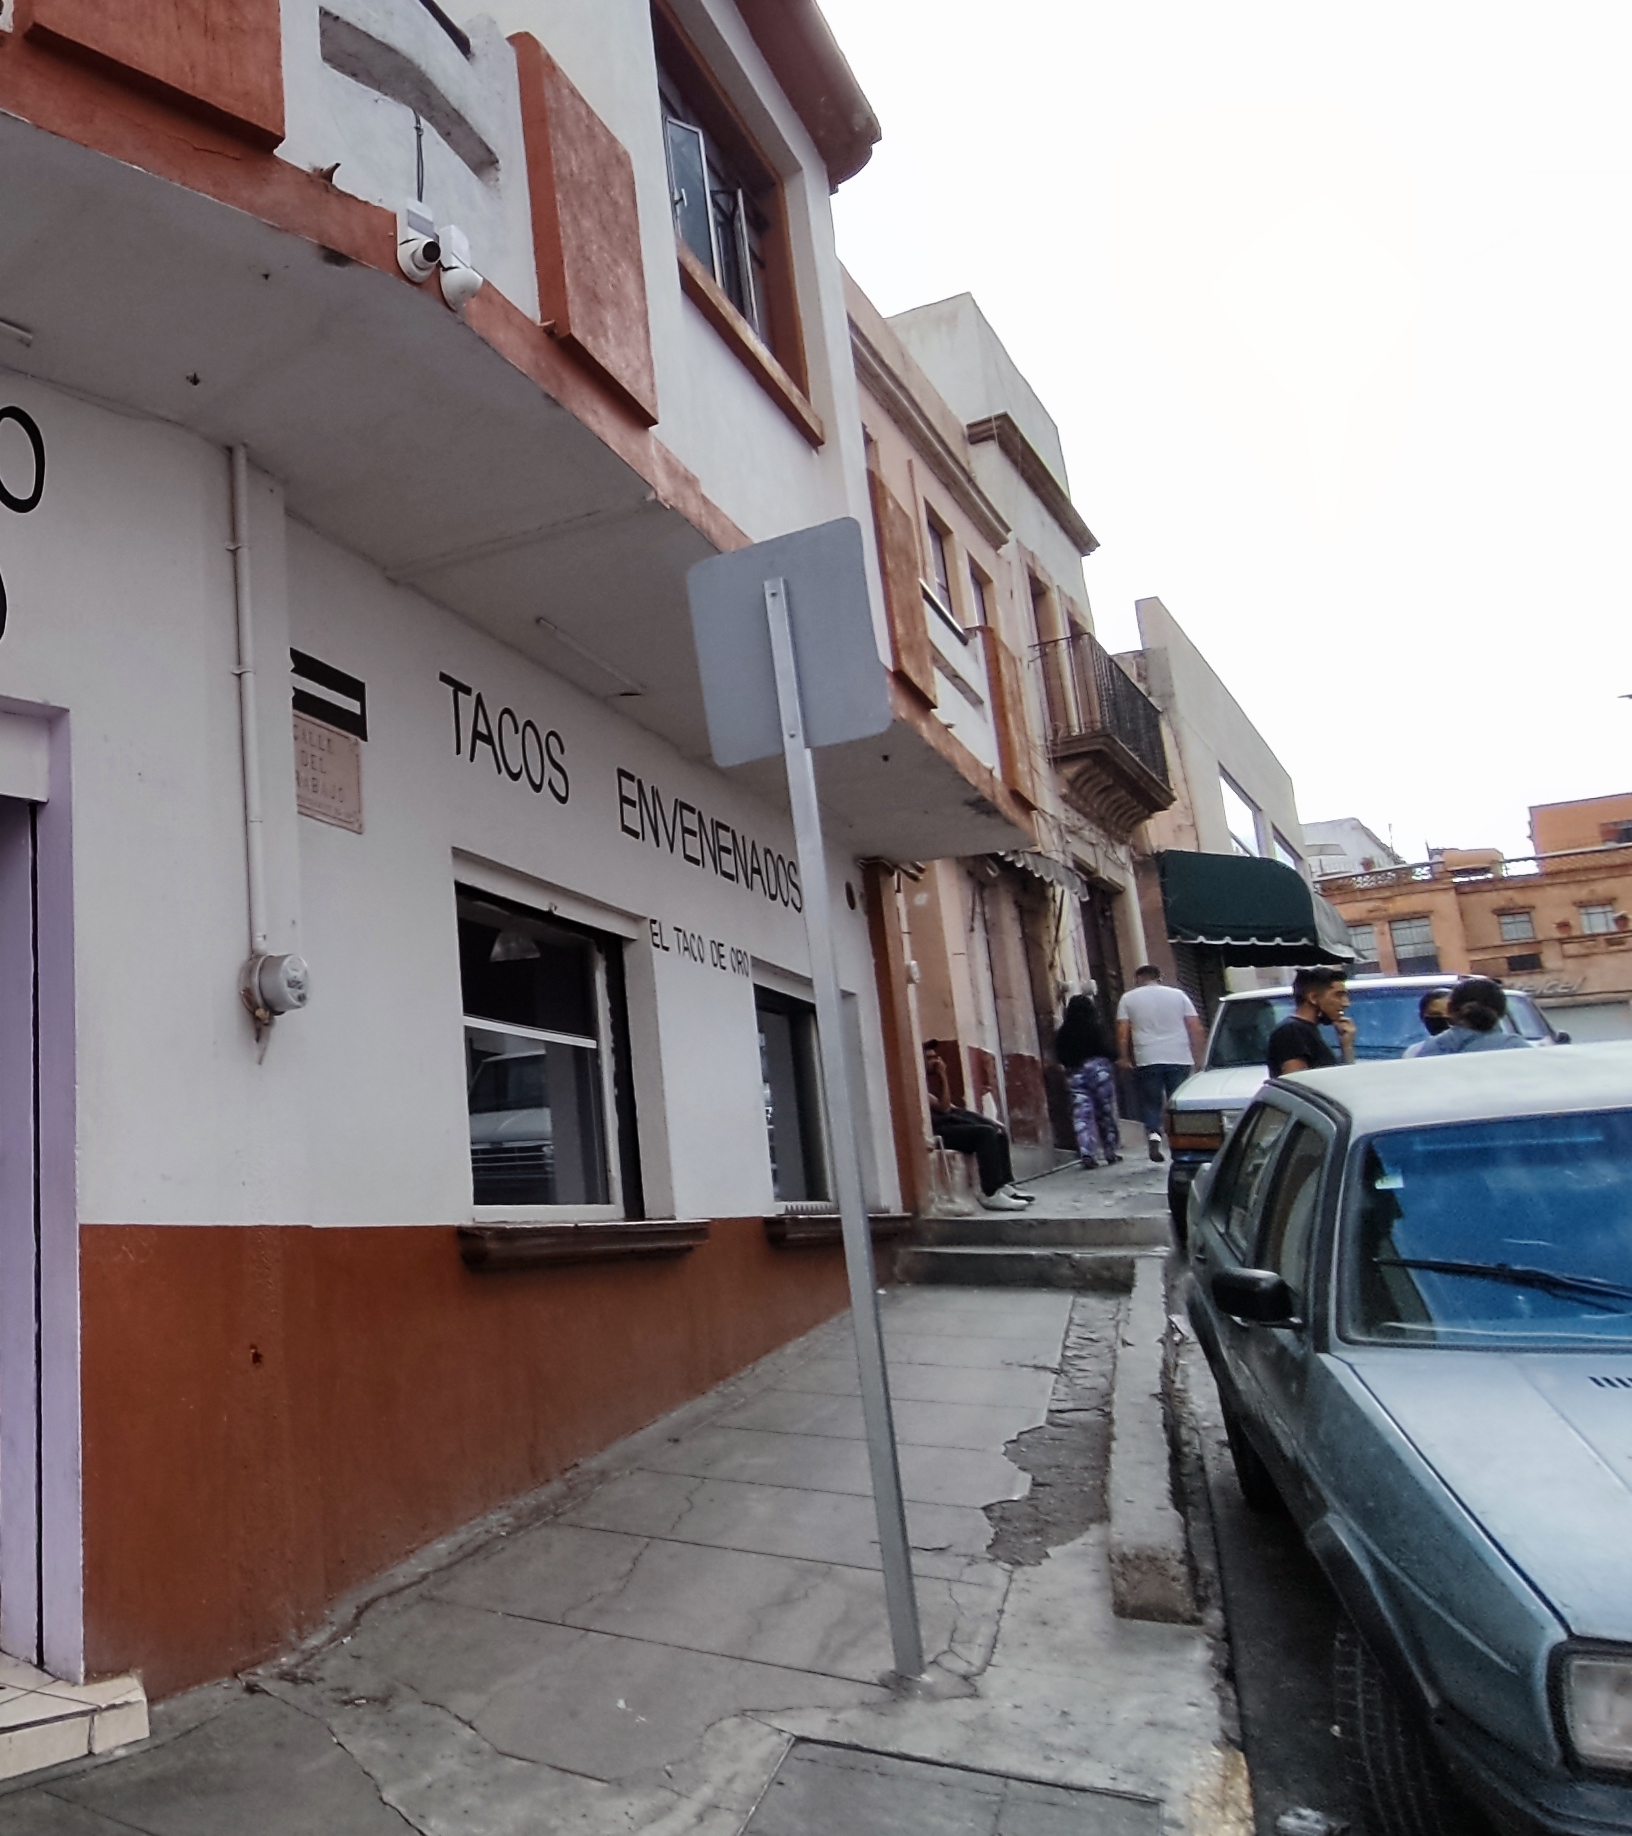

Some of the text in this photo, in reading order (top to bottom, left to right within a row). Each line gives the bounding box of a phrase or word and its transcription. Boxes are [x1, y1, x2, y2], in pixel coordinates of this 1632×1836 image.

[301, 750, 327, 774] DEL
[438, 670, 569, 805] TACOS
[617, 767, 803, 914] ENVENENADOS
[649, 919, 750, 978] EL TACO DE ORO
